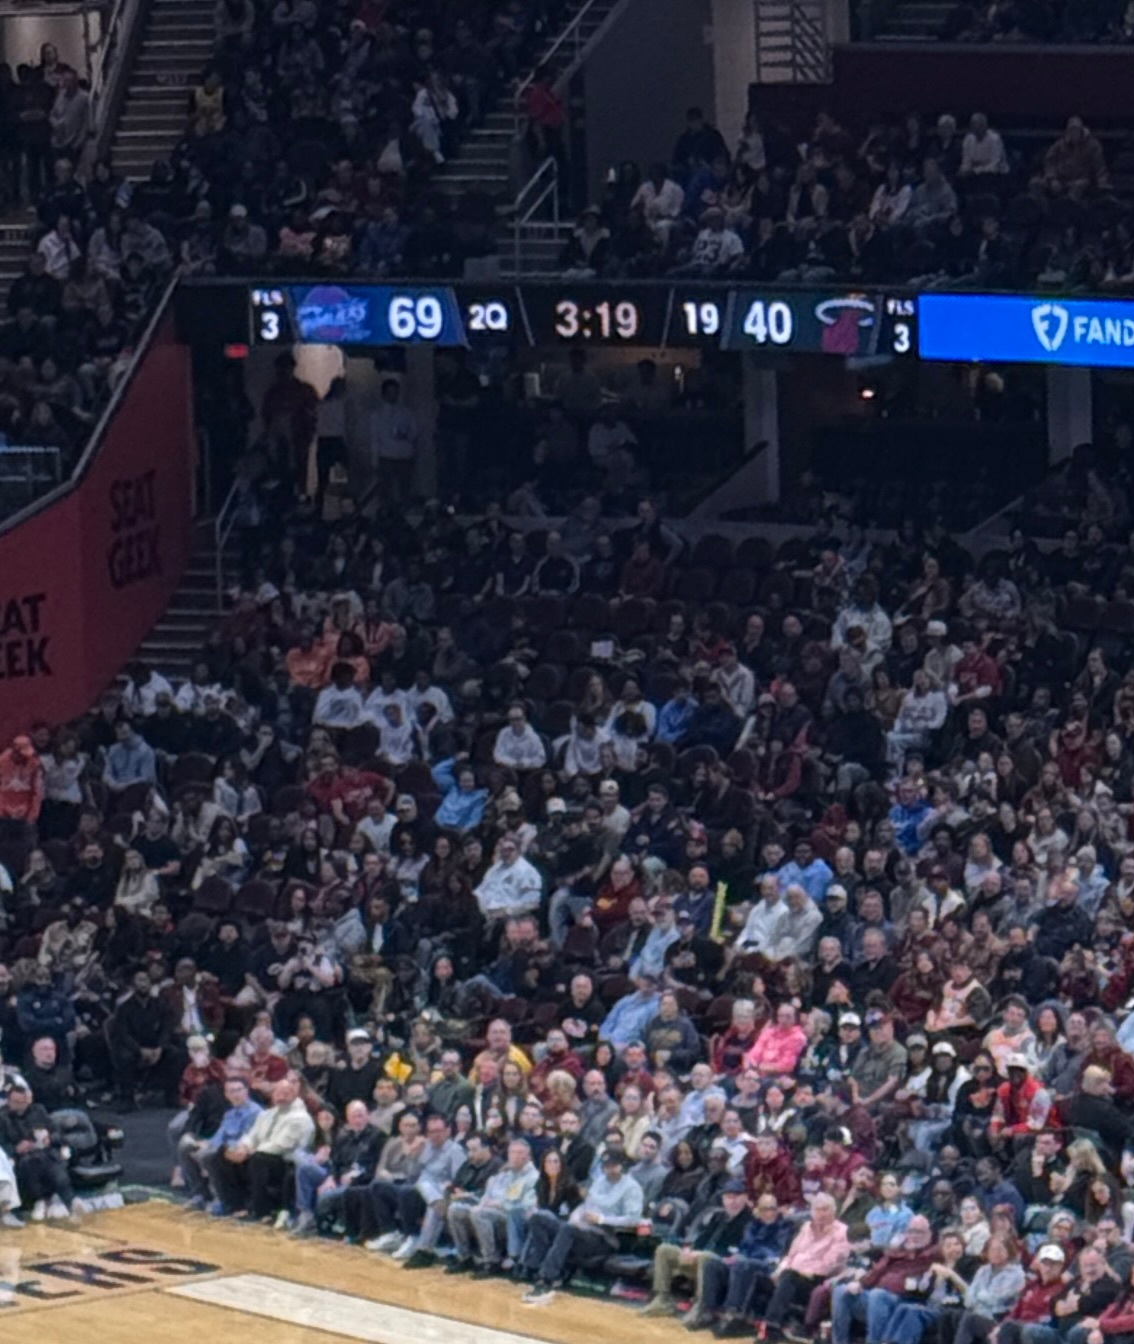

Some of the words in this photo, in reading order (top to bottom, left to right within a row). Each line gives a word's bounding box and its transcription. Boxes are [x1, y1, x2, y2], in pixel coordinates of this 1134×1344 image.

[261, 311, 279, 340] 3
[389, 296, 442, 338] 69
[469, 303, 507, 330] 2Q
[555, 301, 638, 338] 3:19
[683, 303, 719, 334] 19
[743, 300, 793, 344] 40
[894, 323, 910, 352] 3
[0, 592, 47, 636] AT
[0, 636, 53, 680] EK
